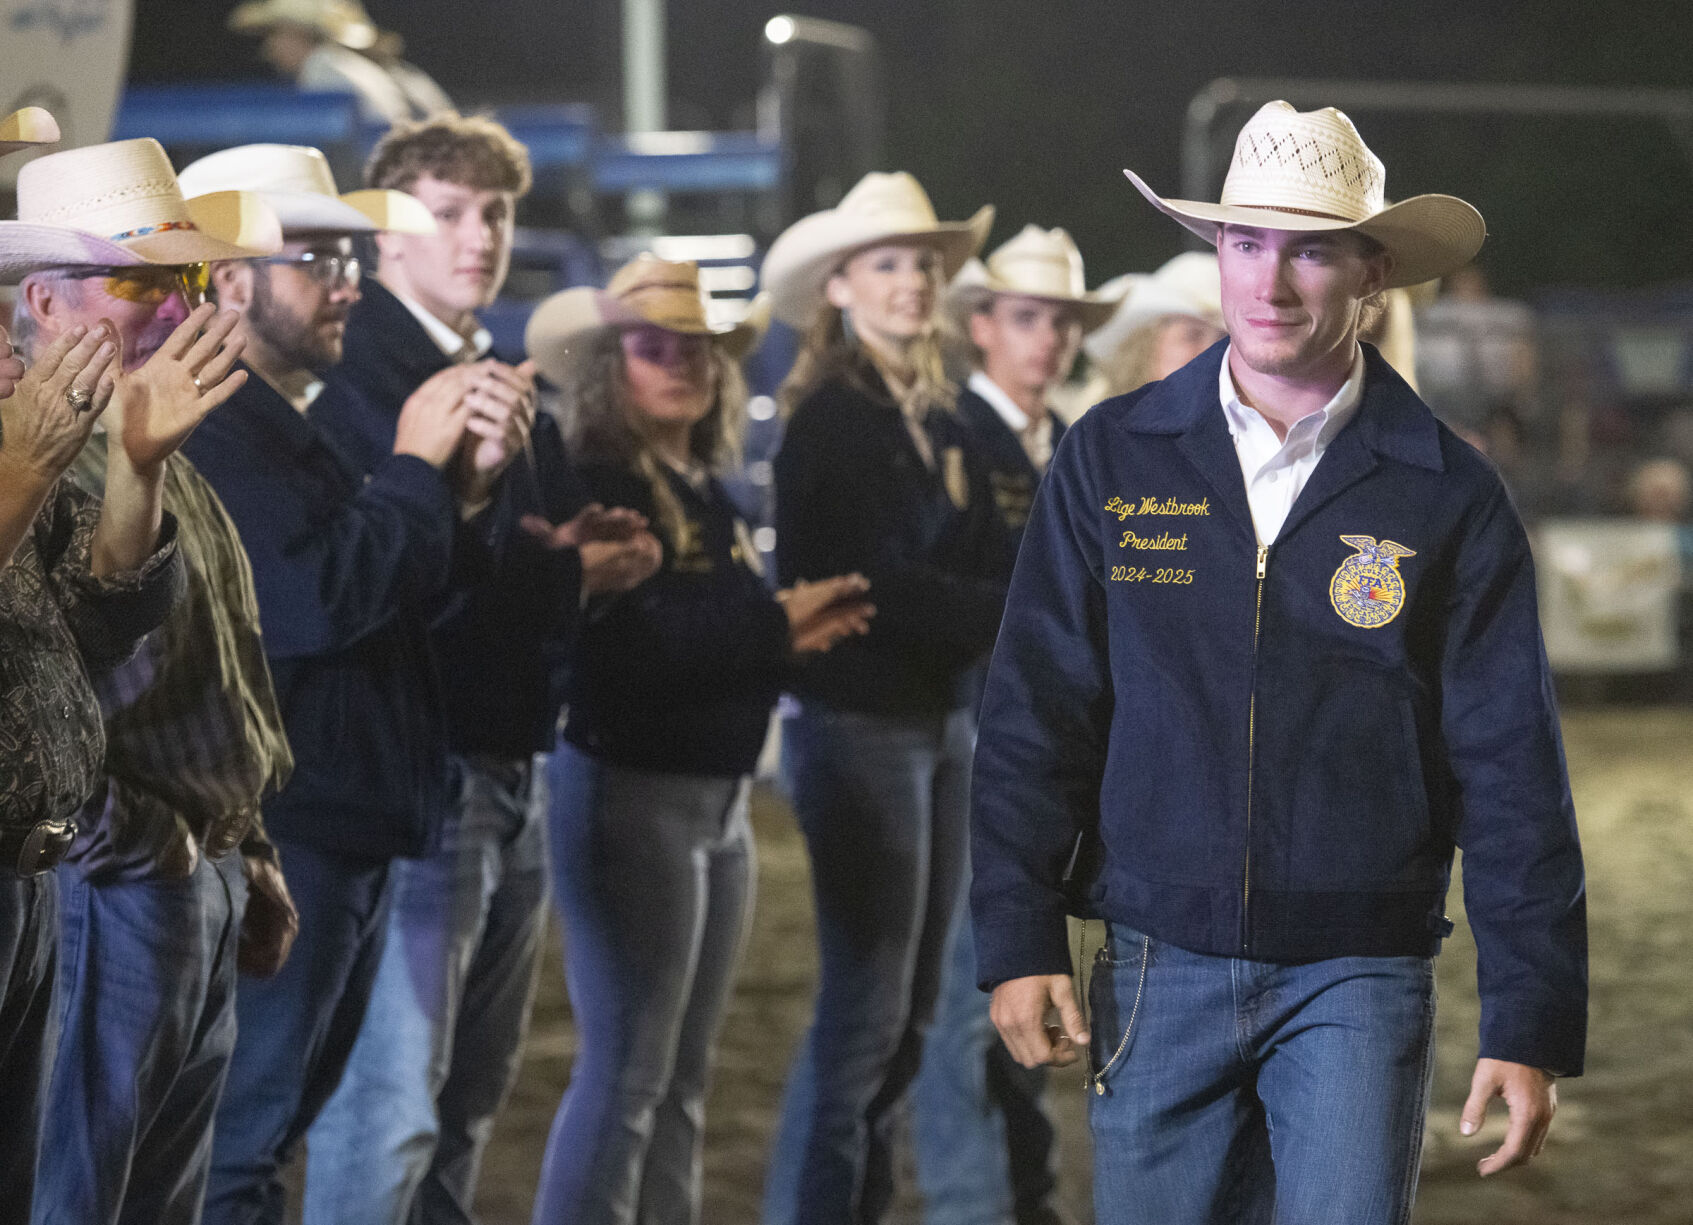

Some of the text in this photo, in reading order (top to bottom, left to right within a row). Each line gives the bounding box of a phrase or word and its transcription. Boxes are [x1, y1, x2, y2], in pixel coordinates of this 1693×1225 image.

[1104, 496, 1211, 521] Lige Westbrook
[1119, 530, 1188, 551] President
[1110, 565, 1196, 584] 2024-2025
[1359, 575, 1383, 588] FFA
